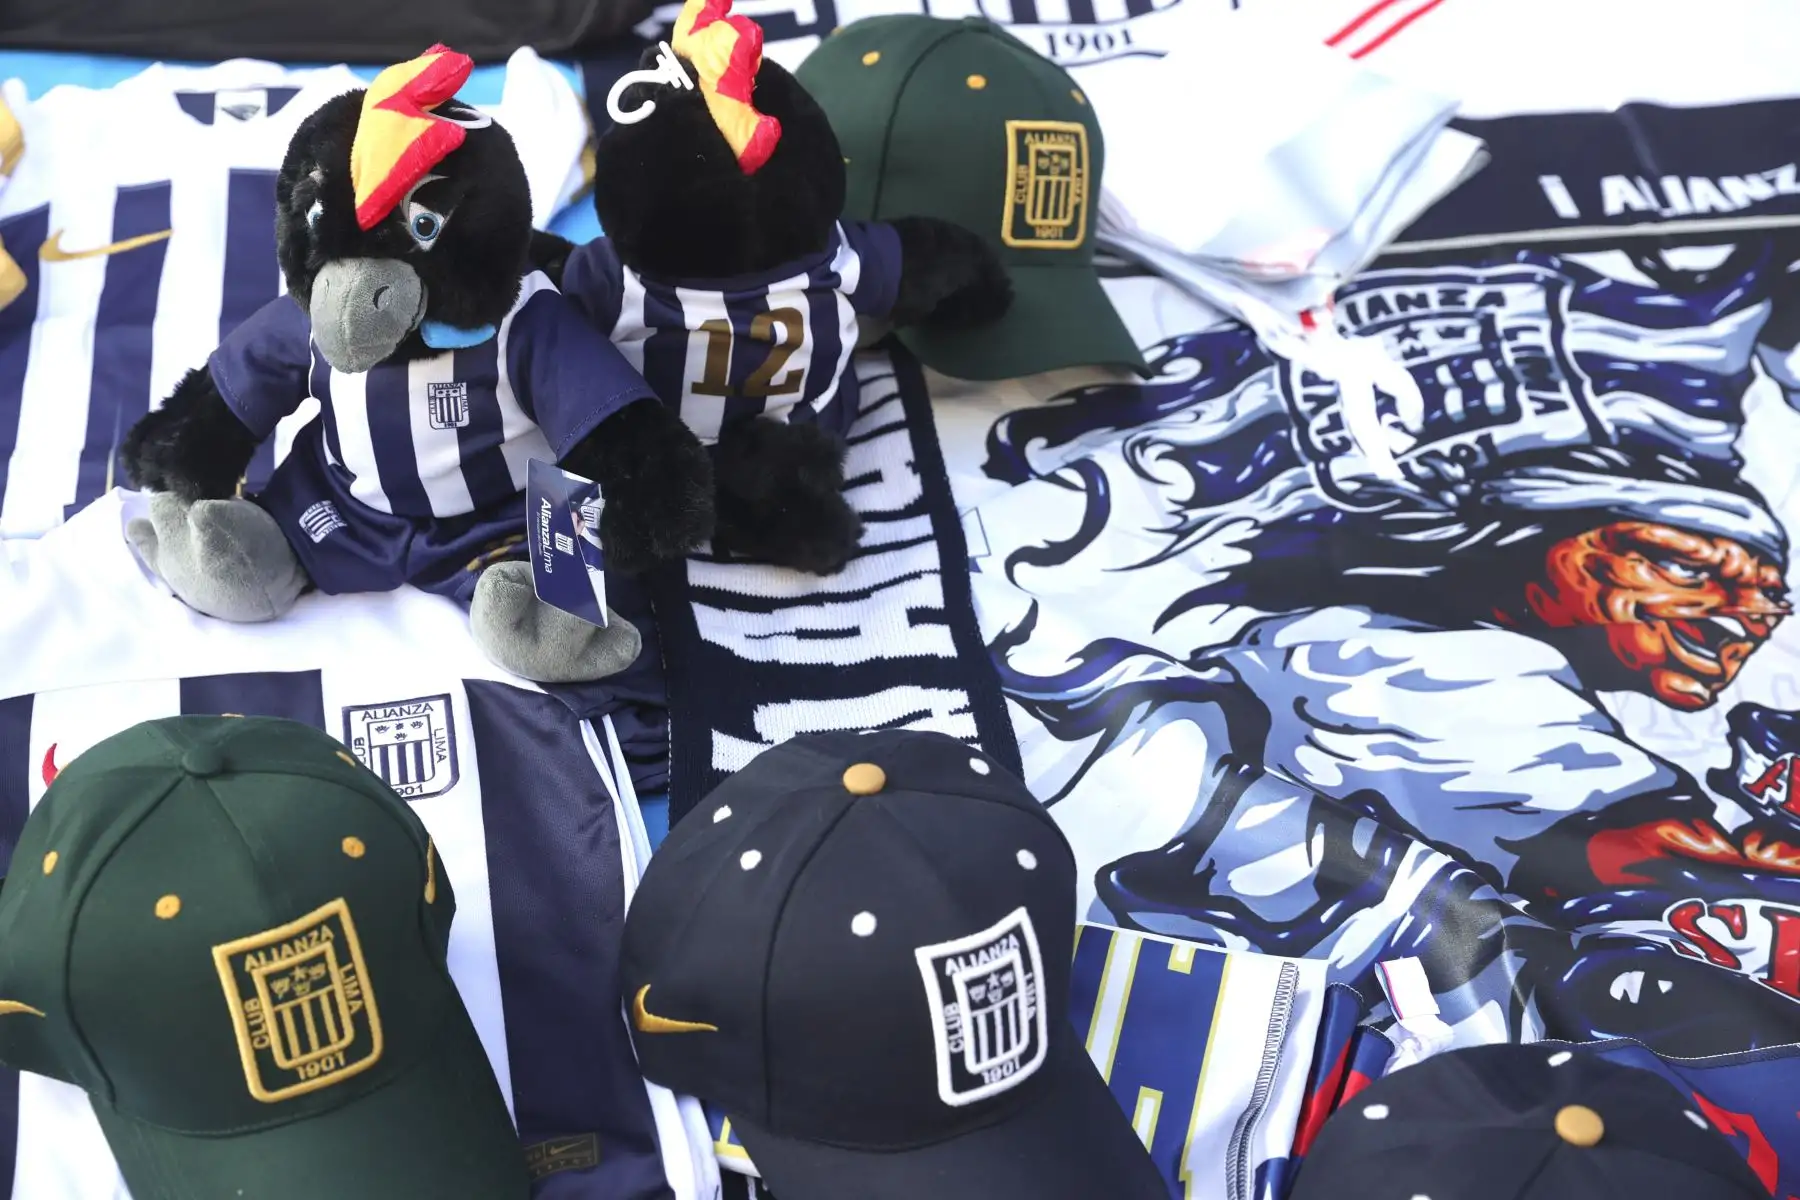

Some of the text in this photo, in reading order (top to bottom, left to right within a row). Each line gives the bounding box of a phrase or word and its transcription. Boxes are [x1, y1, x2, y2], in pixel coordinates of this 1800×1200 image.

[1046, 29, 1134, 57] 1901
[1338, 288, 1506, 338] IANZA
[691, 307, 804, 396] 12
[361, 702, 434, 722] ALIANZA
[433, 727, 447, 764] LIMA
[394, 784, 424, 796] 901
[244, 924, 335, 973] ALIANZA
[944, 933, 1020, 977] ALIANZA
[340, 962, 364, 1015] LIMA
[243, 998, 271, 1050] CLUB
[943, 1002, 965, 1054] CLUB
[296, 1051, 347, 1081] 1901
[980, 1055, 1021, 1086] 1901
